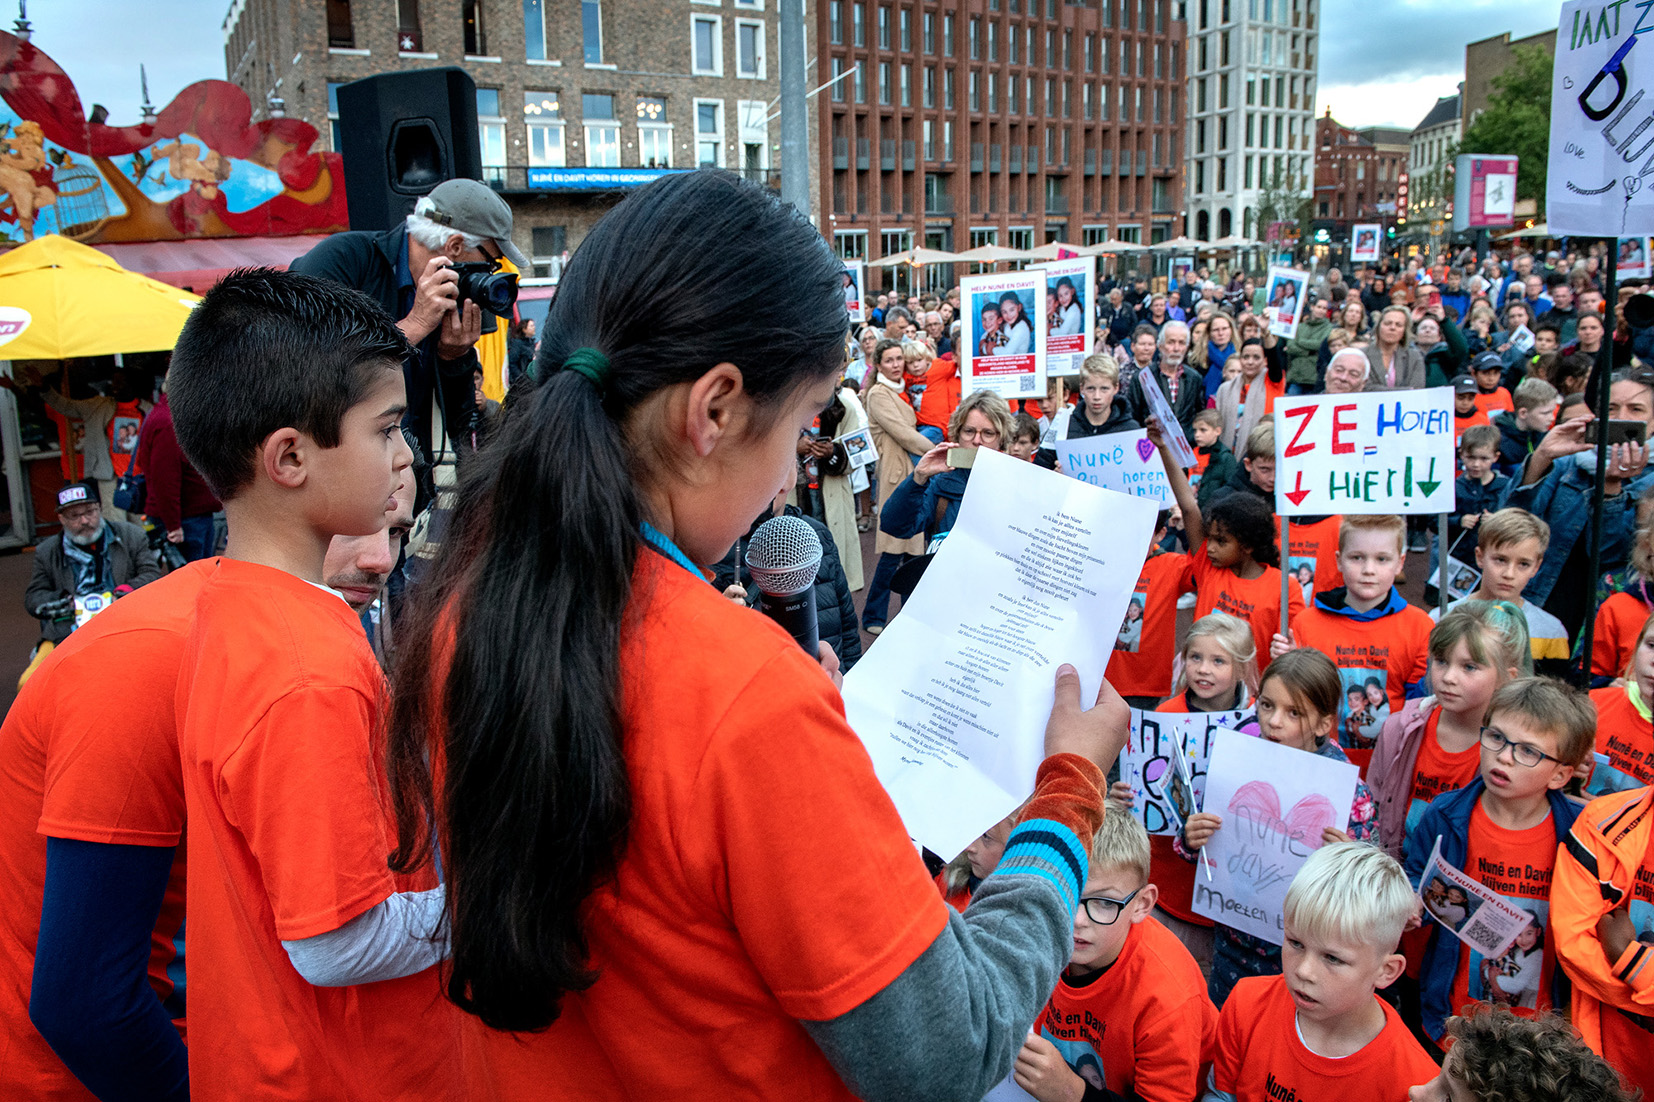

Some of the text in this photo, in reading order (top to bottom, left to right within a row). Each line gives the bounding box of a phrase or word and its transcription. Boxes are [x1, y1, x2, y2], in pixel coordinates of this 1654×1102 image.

[554, 173, 563, 182] EN
[564, 173, 585, 182] DAVIT
[971, 284, 986, 292] HELP
[1284, 404, 1357, 458] ZE
[1358, 647, 1367, 655] en
[1370, 645, 1389, 657] Davit
[1338, 657, 1364, 667] blijven
[1631, 749, 1644, 761] en
[1478, 857, 1504, 874] Nunë
[1508, 866, 1521, 878] en
[1436, 858, 1454, 878] HELP
[1482, 892, 1496, 904] EN
[1496, 901, 1525, 922] DAVIT
[1066, 1014, 1080, 1024] en
[1265, 1072, 1296, 1102] Nunë
